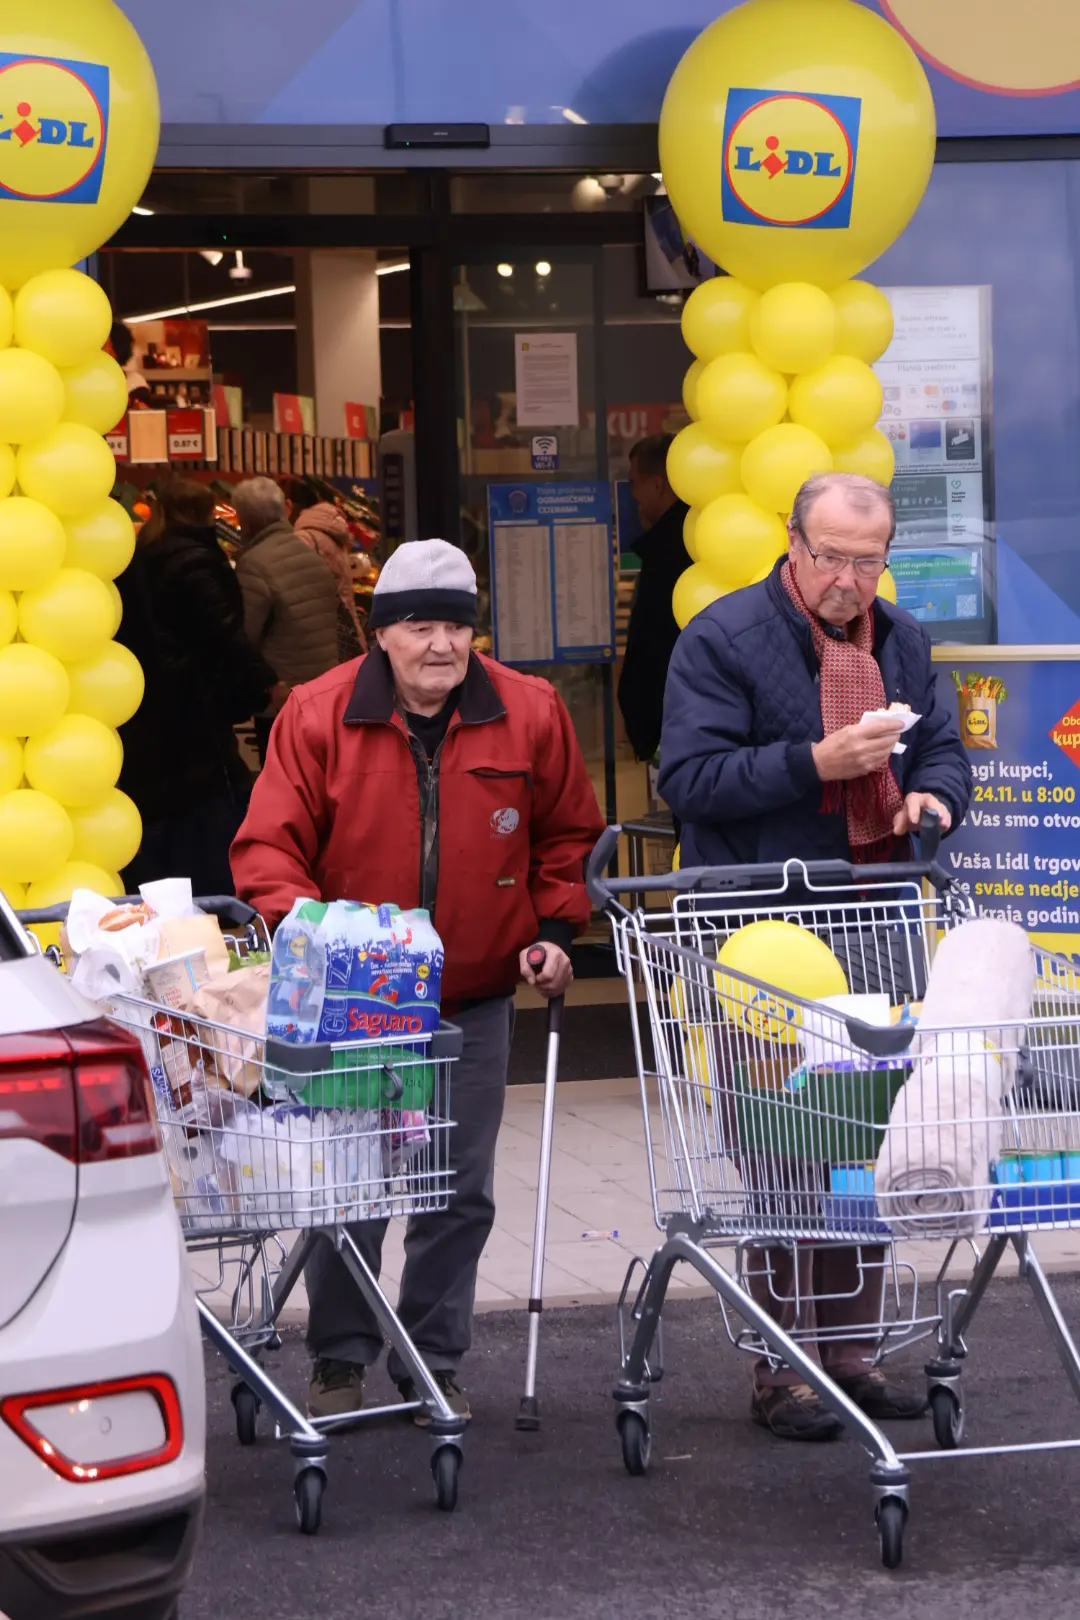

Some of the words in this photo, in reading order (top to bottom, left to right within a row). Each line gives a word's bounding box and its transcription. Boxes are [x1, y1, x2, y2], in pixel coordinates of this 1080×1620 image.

[1000, 760, 1053, 782] kupci,
[974, 785, 1018, 802] 24.11.
[1022, 790, 1033, 802] u
[1037, 786, 1076, 803] 8:00
[970, 810, 1001, 827] Vas
[1004, 814, 1040, 828] smo
[949, 852, 992, 869] Vaša
[996, 852, 1030, 870] Lidl
[975, 879, 1025, 896] svake
[348, 1007, 424, 1037] Saguaro
